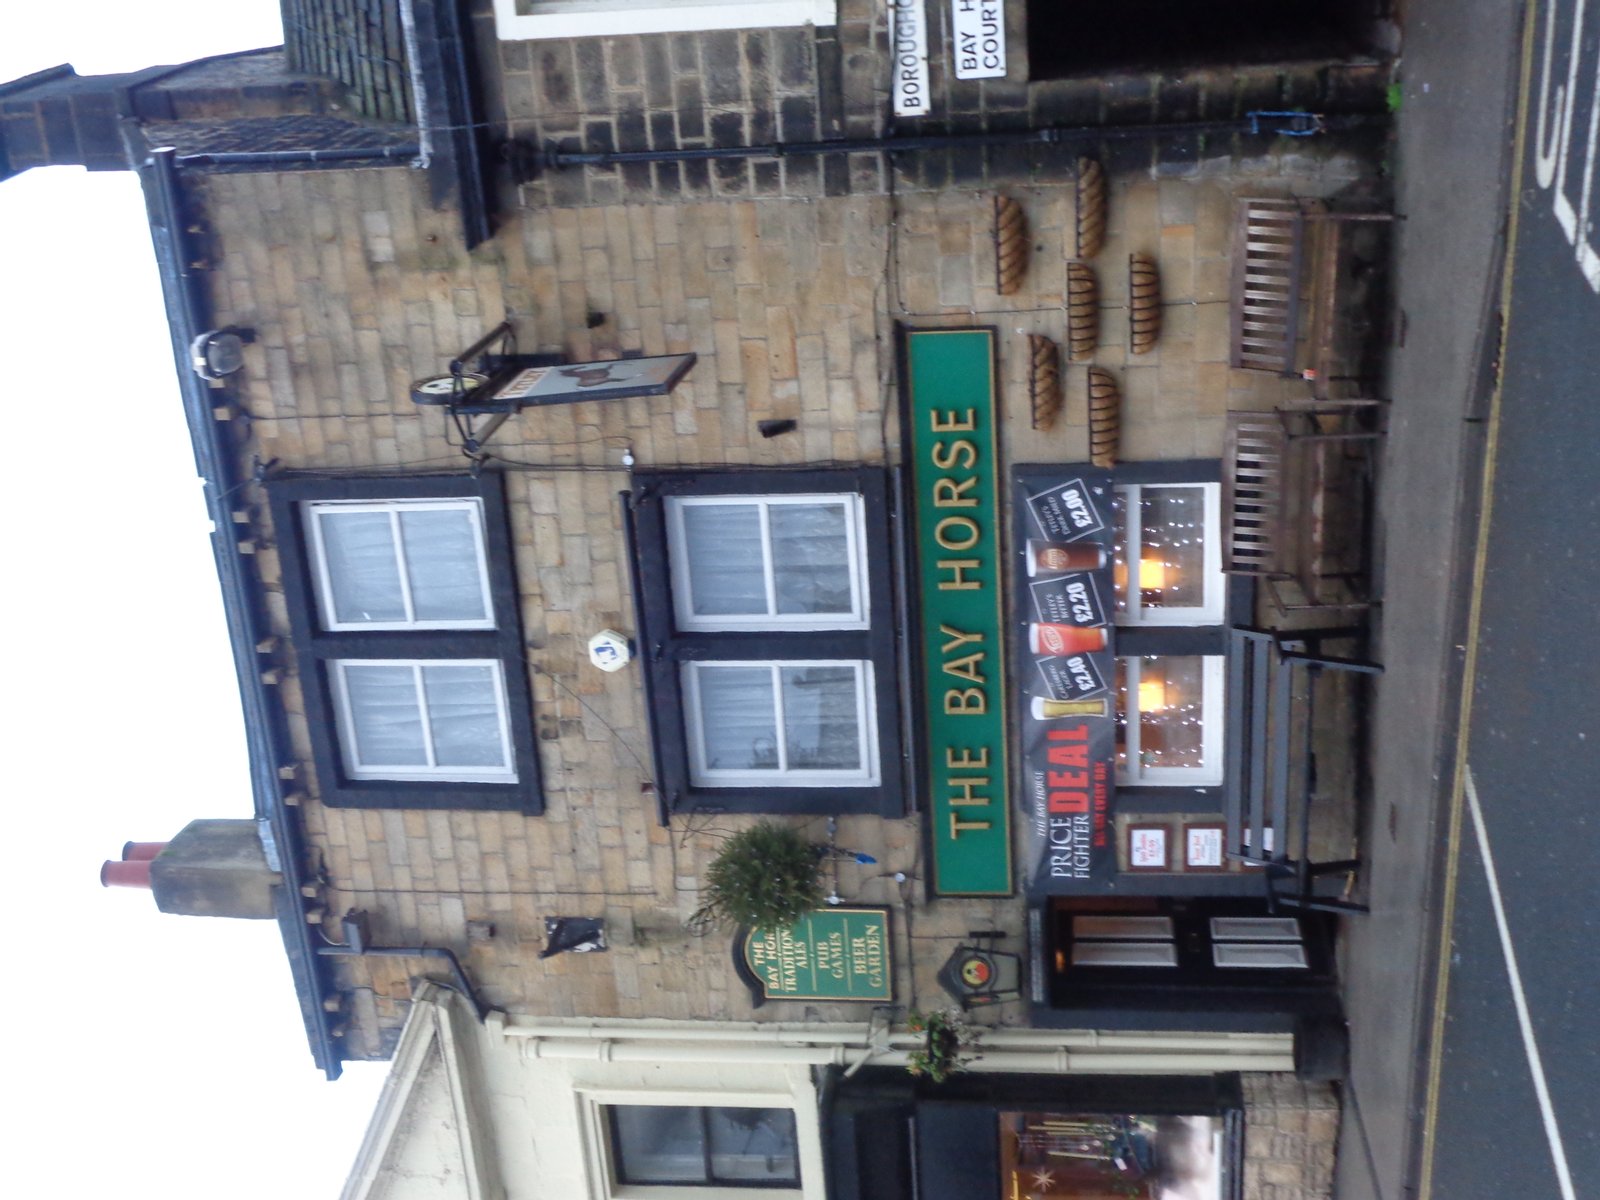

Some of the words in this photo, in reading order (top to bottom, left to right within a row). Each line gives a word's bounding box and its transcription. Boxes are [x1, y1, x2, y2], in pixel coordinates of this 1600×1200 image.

[961, 32, 977, 70] BAY
[982, 0, 999, 69] COURT
[930, 407, 982, 591] HORSE
[1061, 489, 1094, 528] £2.00
[1066, 582, 1094, 622] £2.20
[939, 622, 987, 715] BAY
[1066, 656, 1096, 691] £2.40
[1034, 770, 1045, 800] HORSE
[1046, 724, 1090, 813] DEAL
[1094, 761, 1106, 781] DAY
[945, 746, 991, 840] THE
[1036, 801, 1046, 817] BAY
[1094, 783, 1106, 811] EVERY
[1036, 820, 1046, 837] THE
[1049, 816, 1073, 877] PRICE
[1073, 815, 1091, 879] FIGHTER
[752, 941, 766, 966] THE
[765, 931, 777, 960] HOR
[781, 928, 798, 992] TRADITION
[795, 941, 809, 969] ALES
[817, 942, 830, 969] PUB
[829, 932, 844, 978] GAMES
[852, 937, 867, 974] BEER
[865, 925, 882, 988] GARDEN
[767, 966, 780, 989] BAY
